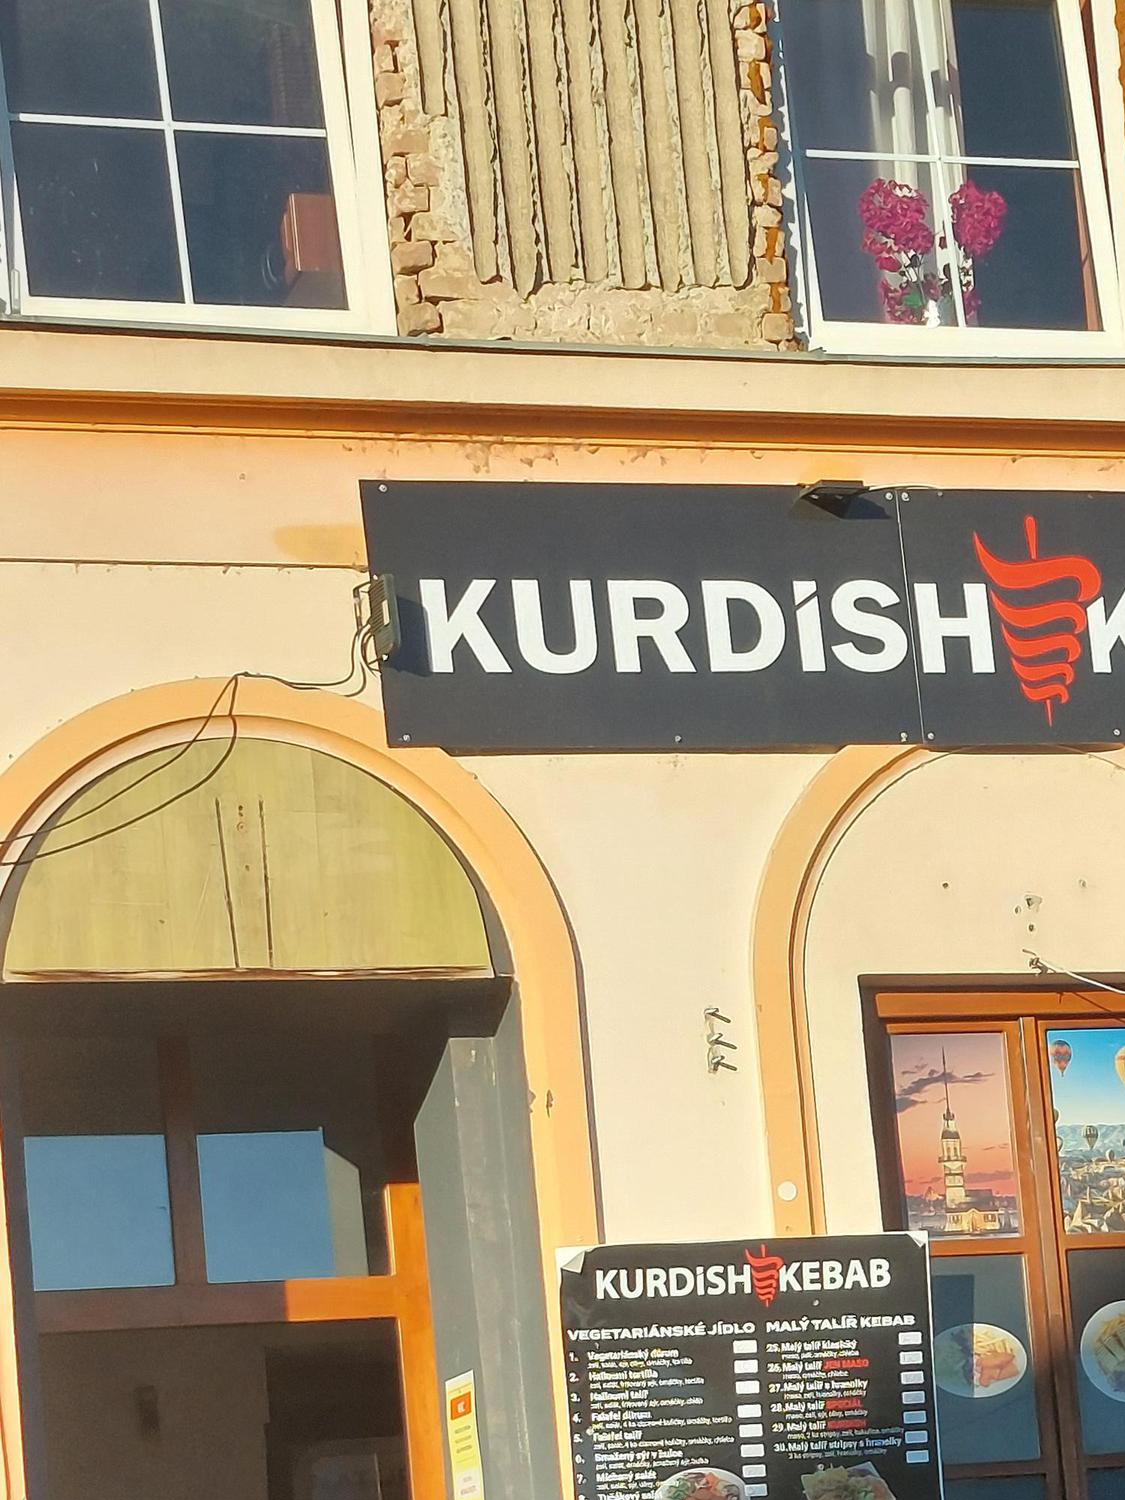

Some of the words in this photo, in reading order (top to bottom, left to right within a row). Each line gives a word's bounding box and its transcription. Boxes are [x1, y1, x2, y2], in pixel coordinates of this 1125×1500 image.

[780, 1258, 891, 1292] KEBAB
[567, 1322, 706, 1341] VEGETARIÁNSKÉ
[707, 1321, 756, 1336] JÍDLO
[766, 1316, 811, 1333] MALÝ
[811, 1315, 858, 1331] TALÍŘ
[860, 1315, 916, 1329] KEBAB
